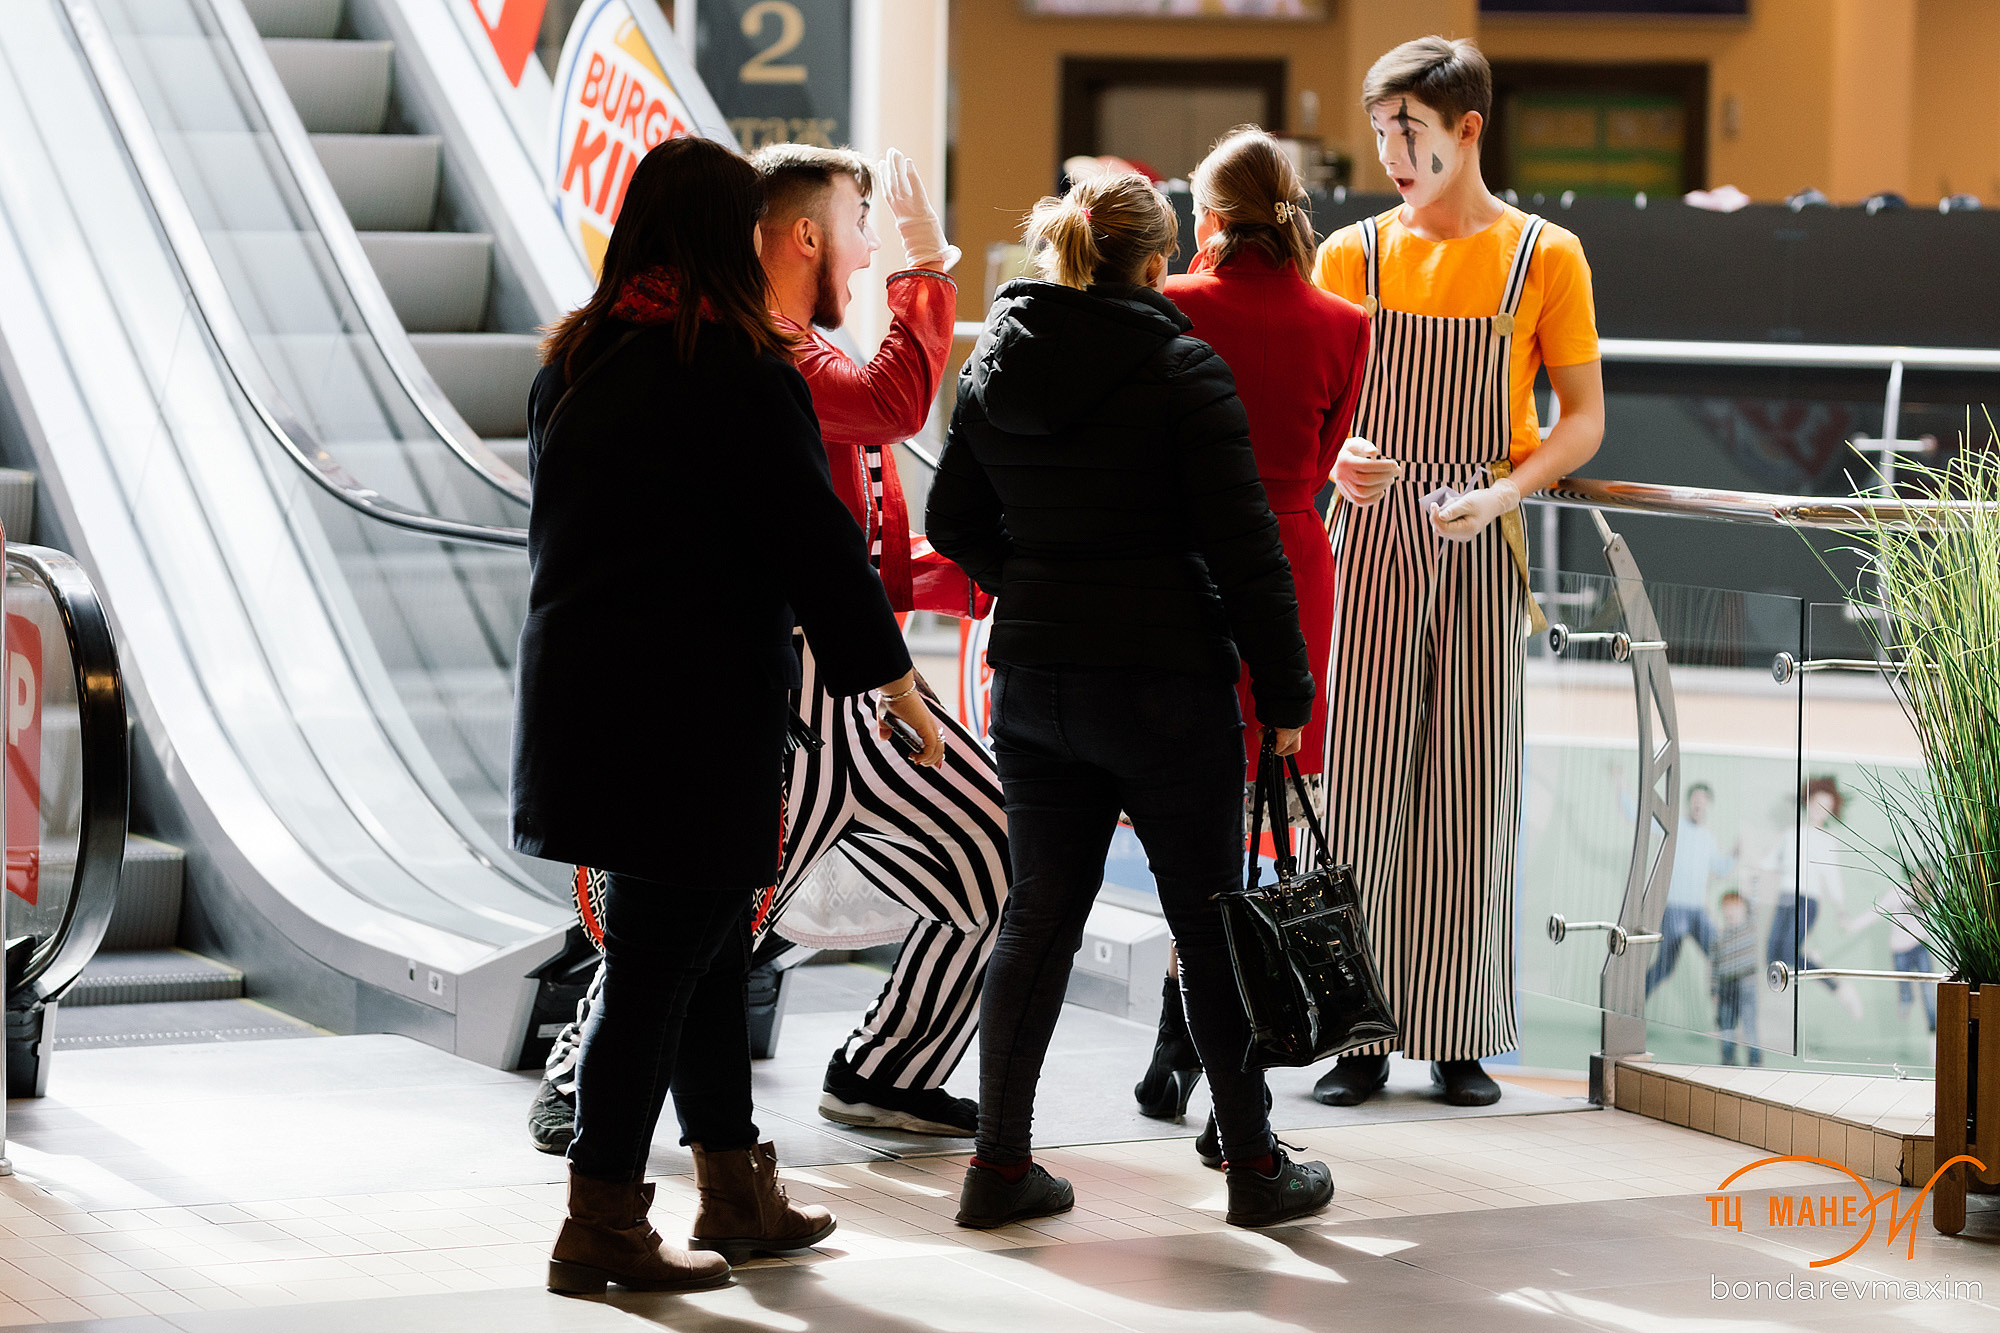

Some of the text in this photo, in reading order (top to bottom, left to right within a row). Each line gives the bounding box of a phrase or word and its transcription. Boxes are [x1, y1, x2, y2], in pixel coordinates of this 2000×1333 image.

[740, 0, 808, 84] 2
[580, 52, 695, 153] BURG
[727, 116, 837, 150] таж
